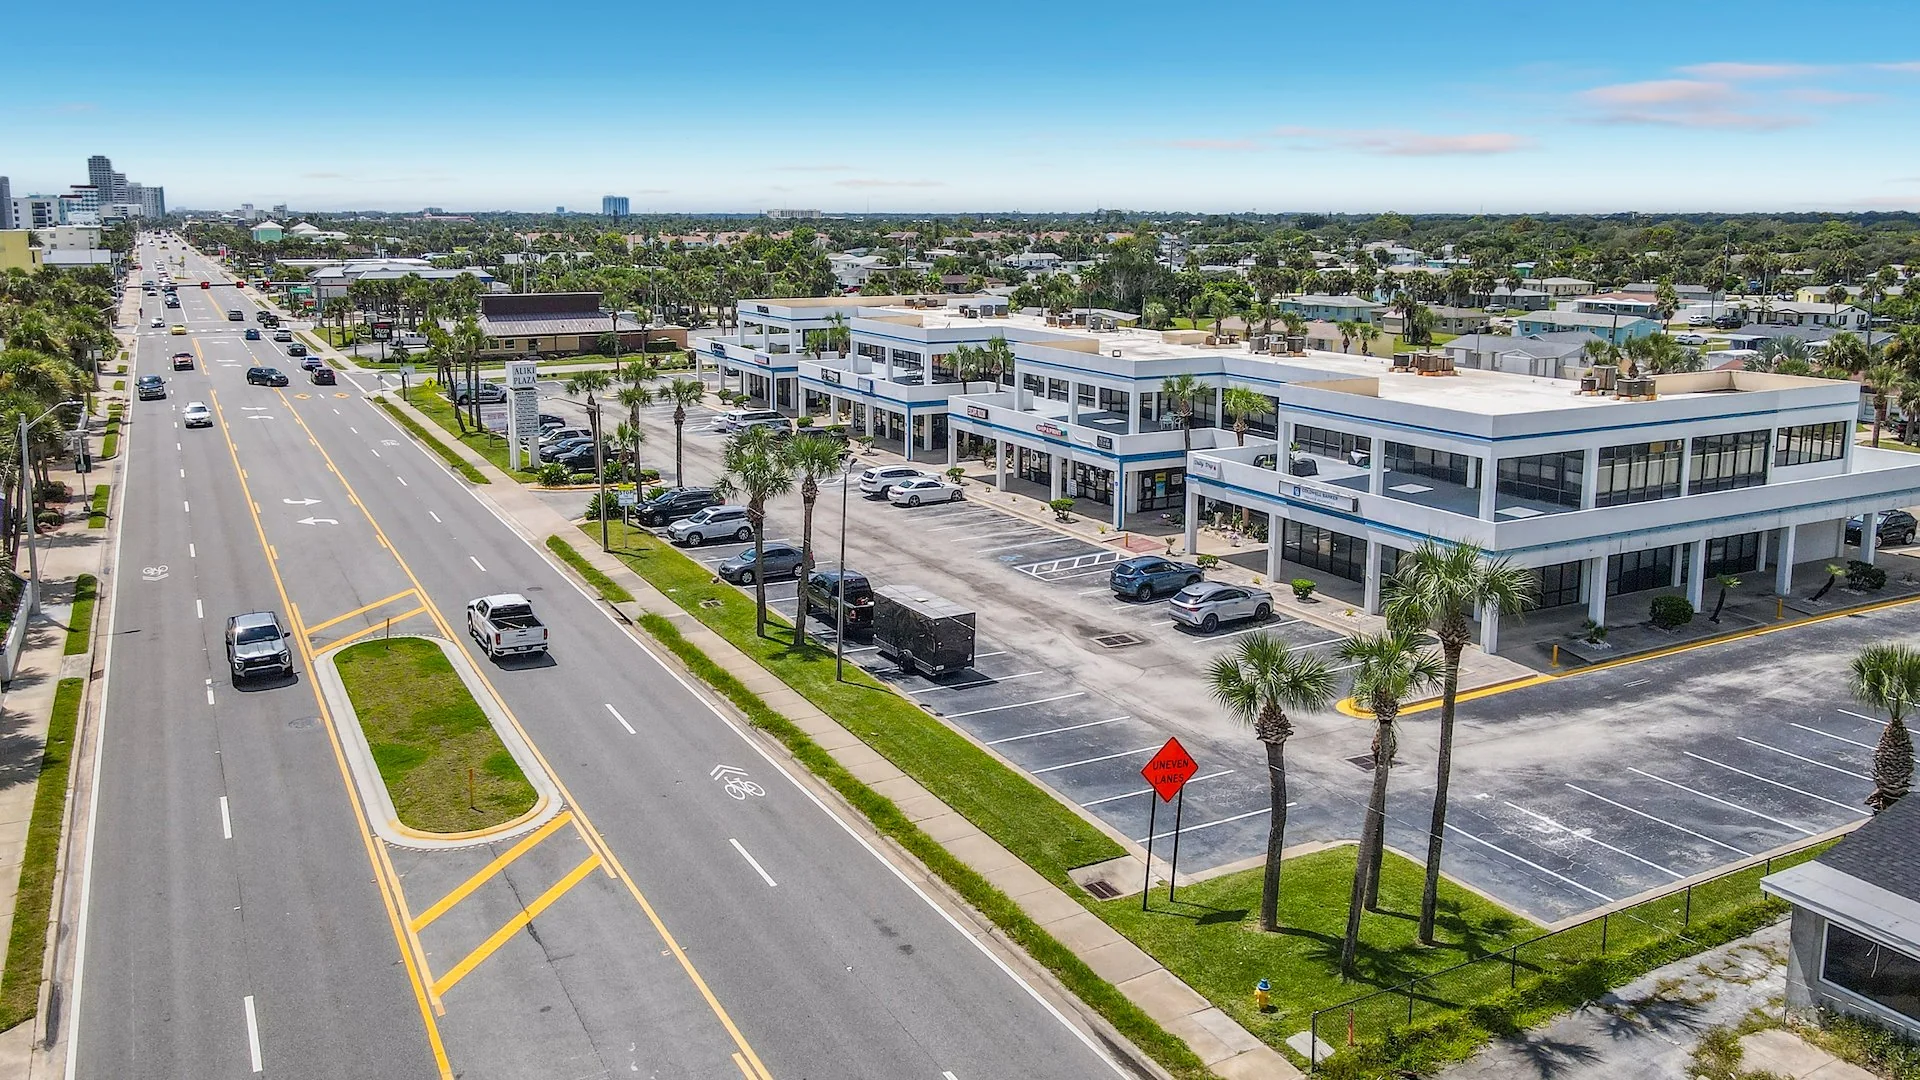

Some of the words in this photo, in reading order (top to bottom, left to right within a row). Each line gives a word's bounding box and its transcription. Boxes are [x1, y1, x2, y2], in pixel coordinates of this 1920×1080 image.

[514, 367, 535, 375] ALIKI
[514, 376, 536, 385] PLAZA
[1152, 759, 1189, 770] UNEVEN
[1155, 773, 1184, 784] LANES
